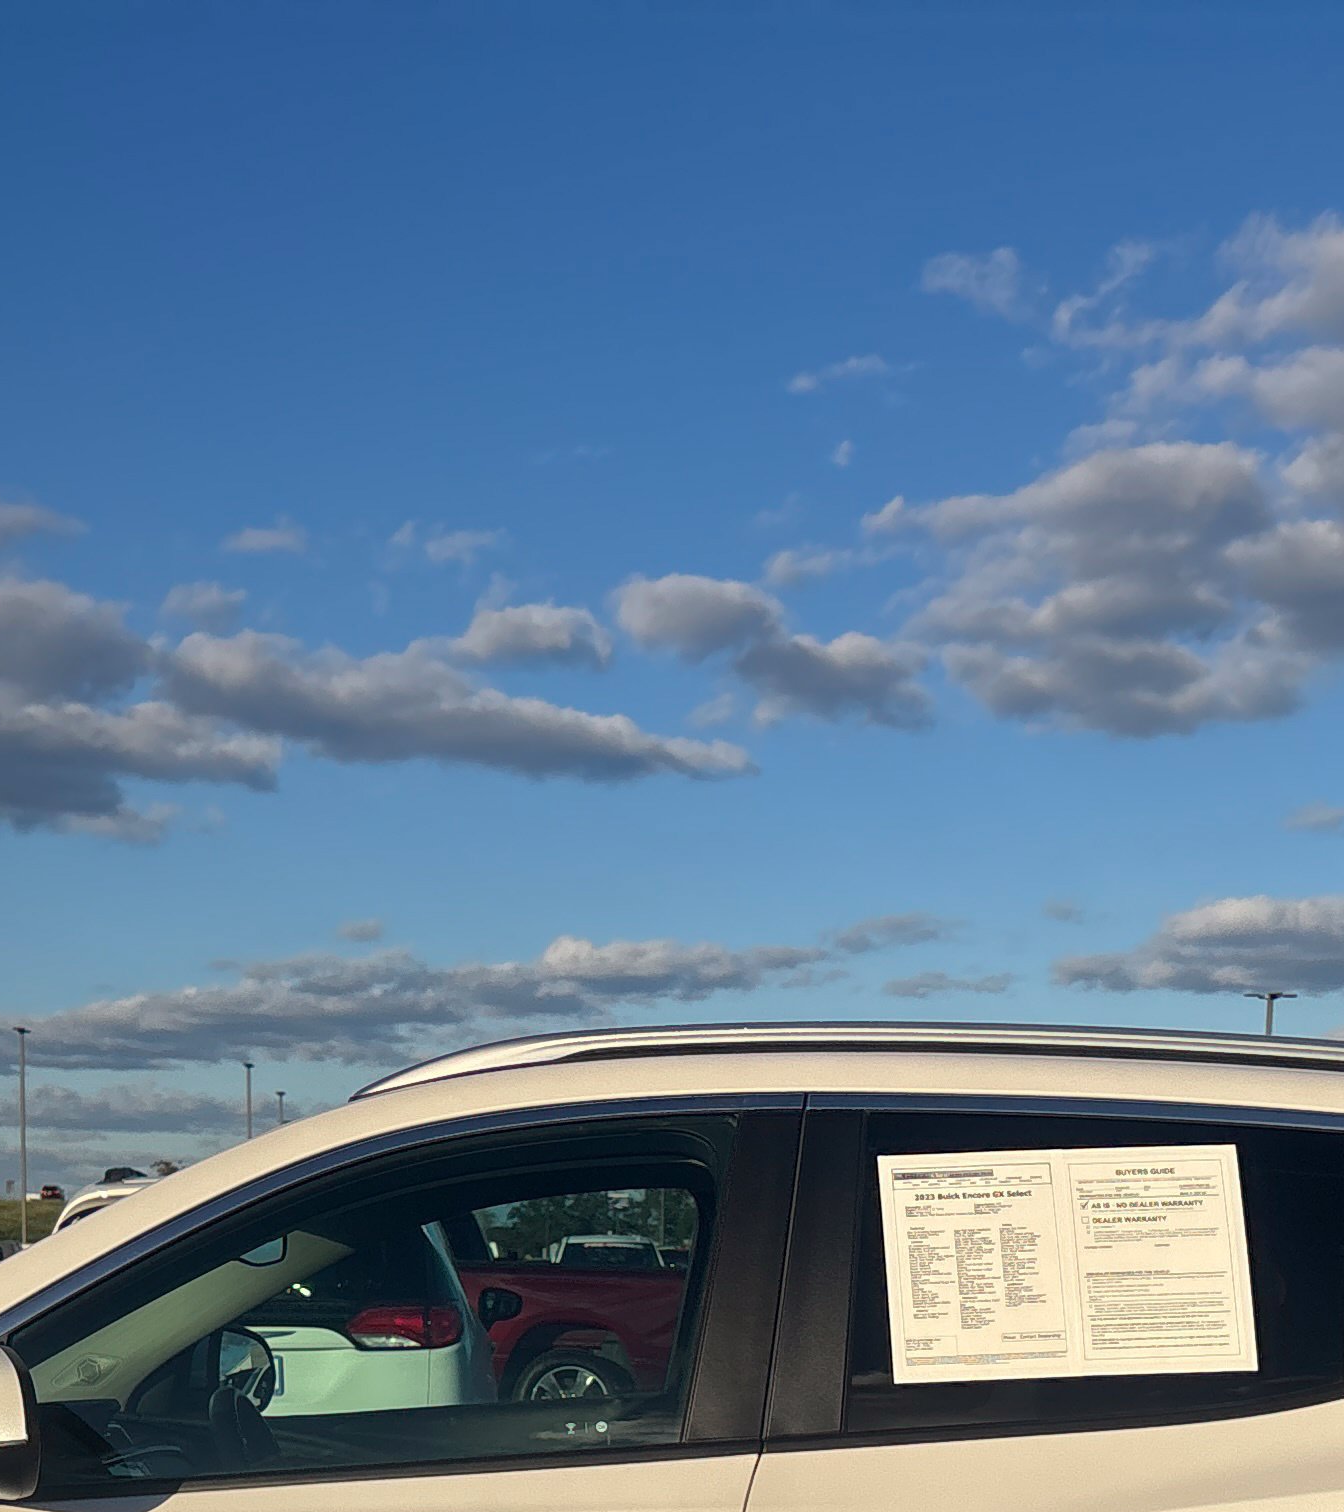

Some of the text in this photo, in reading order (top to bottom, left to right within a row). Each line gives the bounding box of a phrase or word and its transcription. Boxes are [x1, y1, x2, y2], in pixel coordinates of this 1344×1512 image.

[1115, 1167, 1176, 1176] BUYERS GUIDE
[914, 1189, 1033, 1201] 2023 Buick Encore GX Select
[1128, 1200, 1159, 1208] DEALER
[1160, 1199, 1204, 1207] WARRANTY
[1092, 1215, 1167, 1224] DEALER WARRANTY
